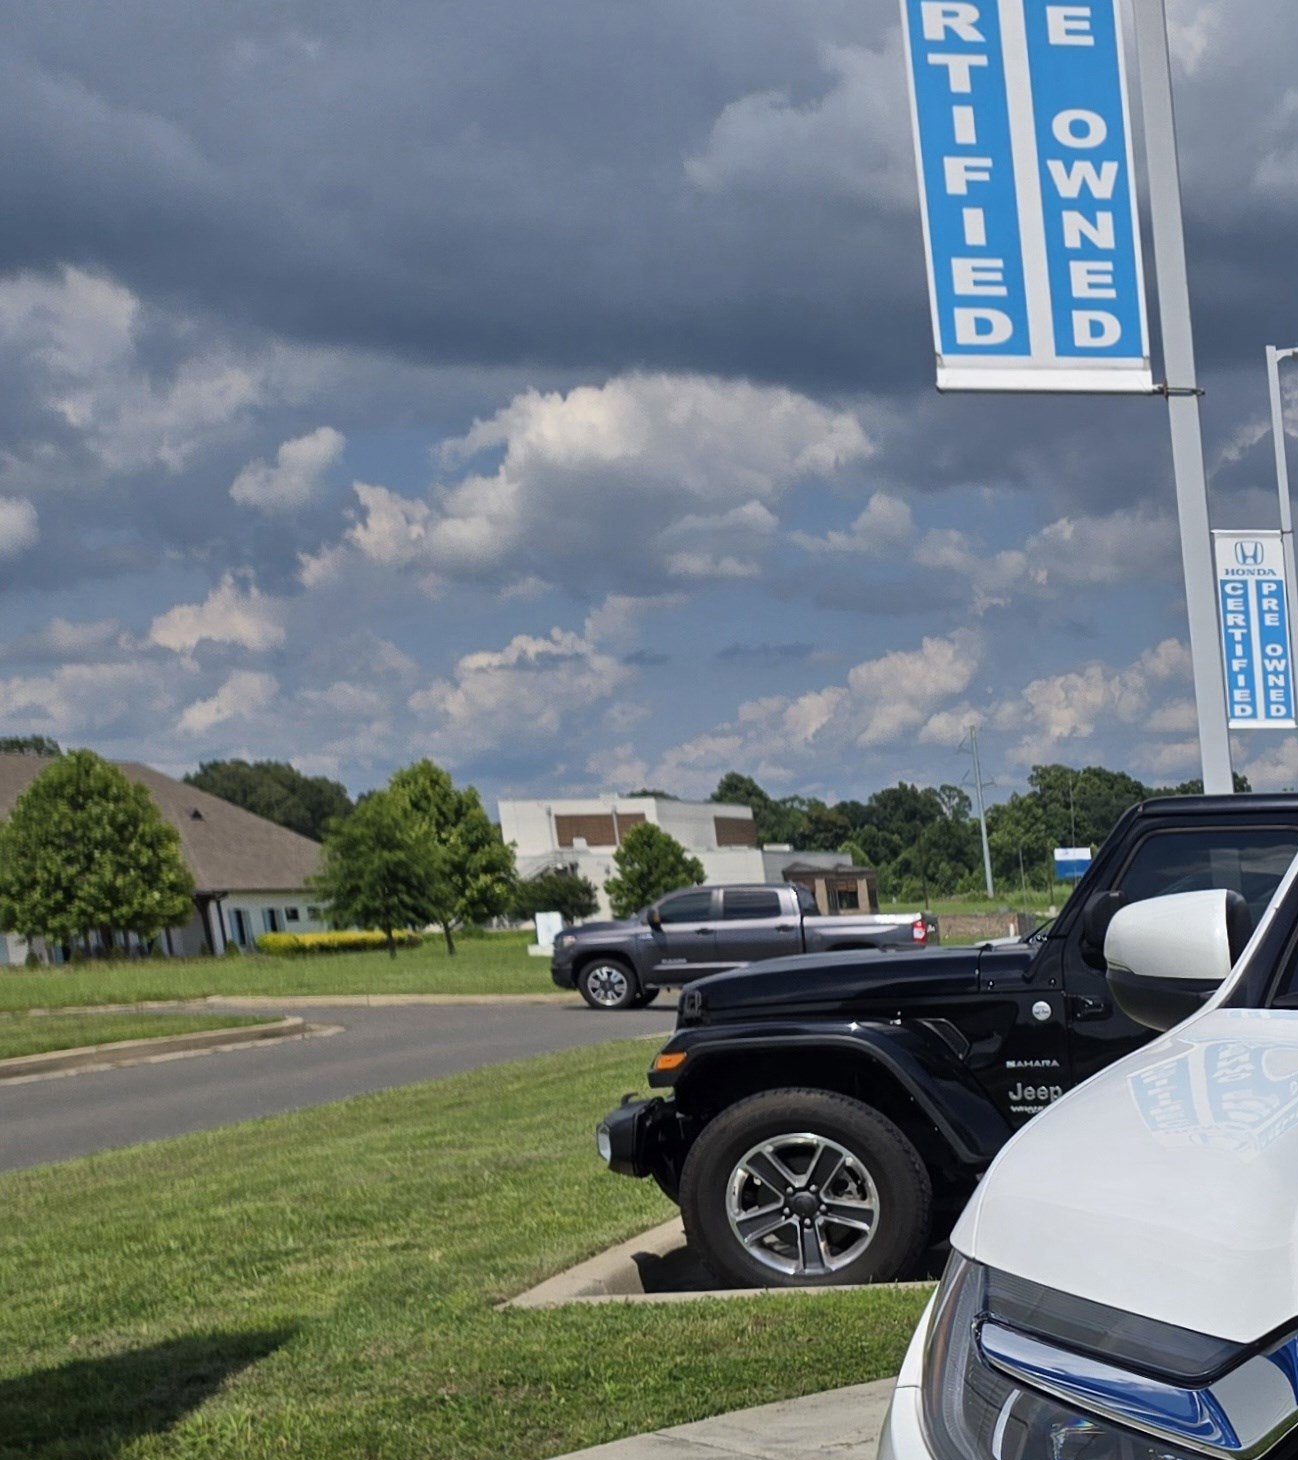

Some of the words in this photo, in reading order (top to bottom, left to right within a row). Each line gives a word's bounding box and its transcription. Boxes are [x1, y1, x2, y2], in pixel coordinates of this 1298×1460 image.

[920, 1, 1014, 346] RTIFIED
[1046, 109, 1122, 347] OWNED
[1224, 568, 1277, 577] HONDA
[1262, 582, 1280, 626] PRE
[1224, 582, 1253, 717] CERTIFIED
[1263, 643, 1287, 717] OWNED
[1006, 1060, 1060, 1068] SAHARA
[1008, 1082, 1063, 1101] Jeep
